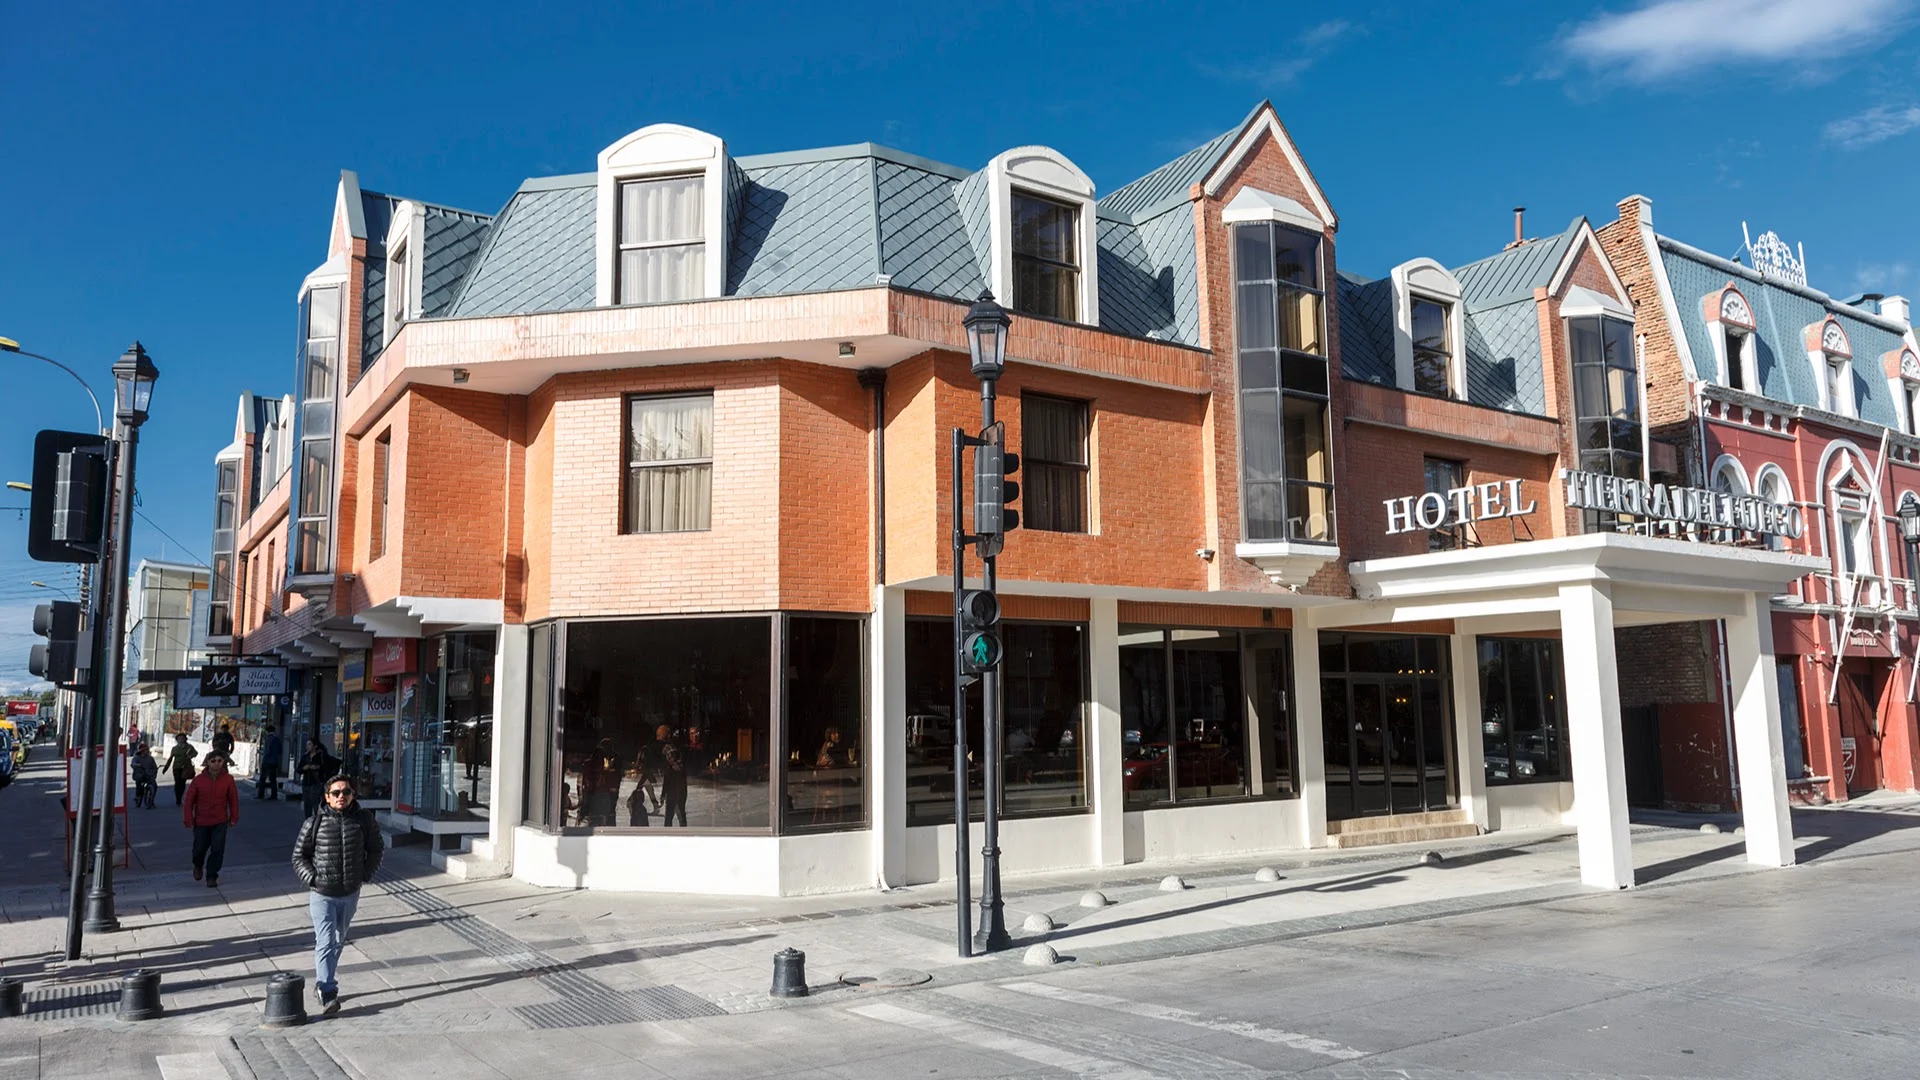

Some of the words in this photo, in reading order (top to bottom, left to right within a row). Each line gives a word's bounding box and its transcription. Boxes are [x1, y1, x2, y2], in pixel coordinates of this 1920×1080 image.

[1382, 480, 1537, 535] HOTEL
[1559, 467, 1676, 519] TIERRA
[1668, 484, 1727, 527] DEL
[1718, 493, 1804, 540] FUEGO
[242, 680, 281, 691] Morgan
[248, 669, 277, 680] Black
